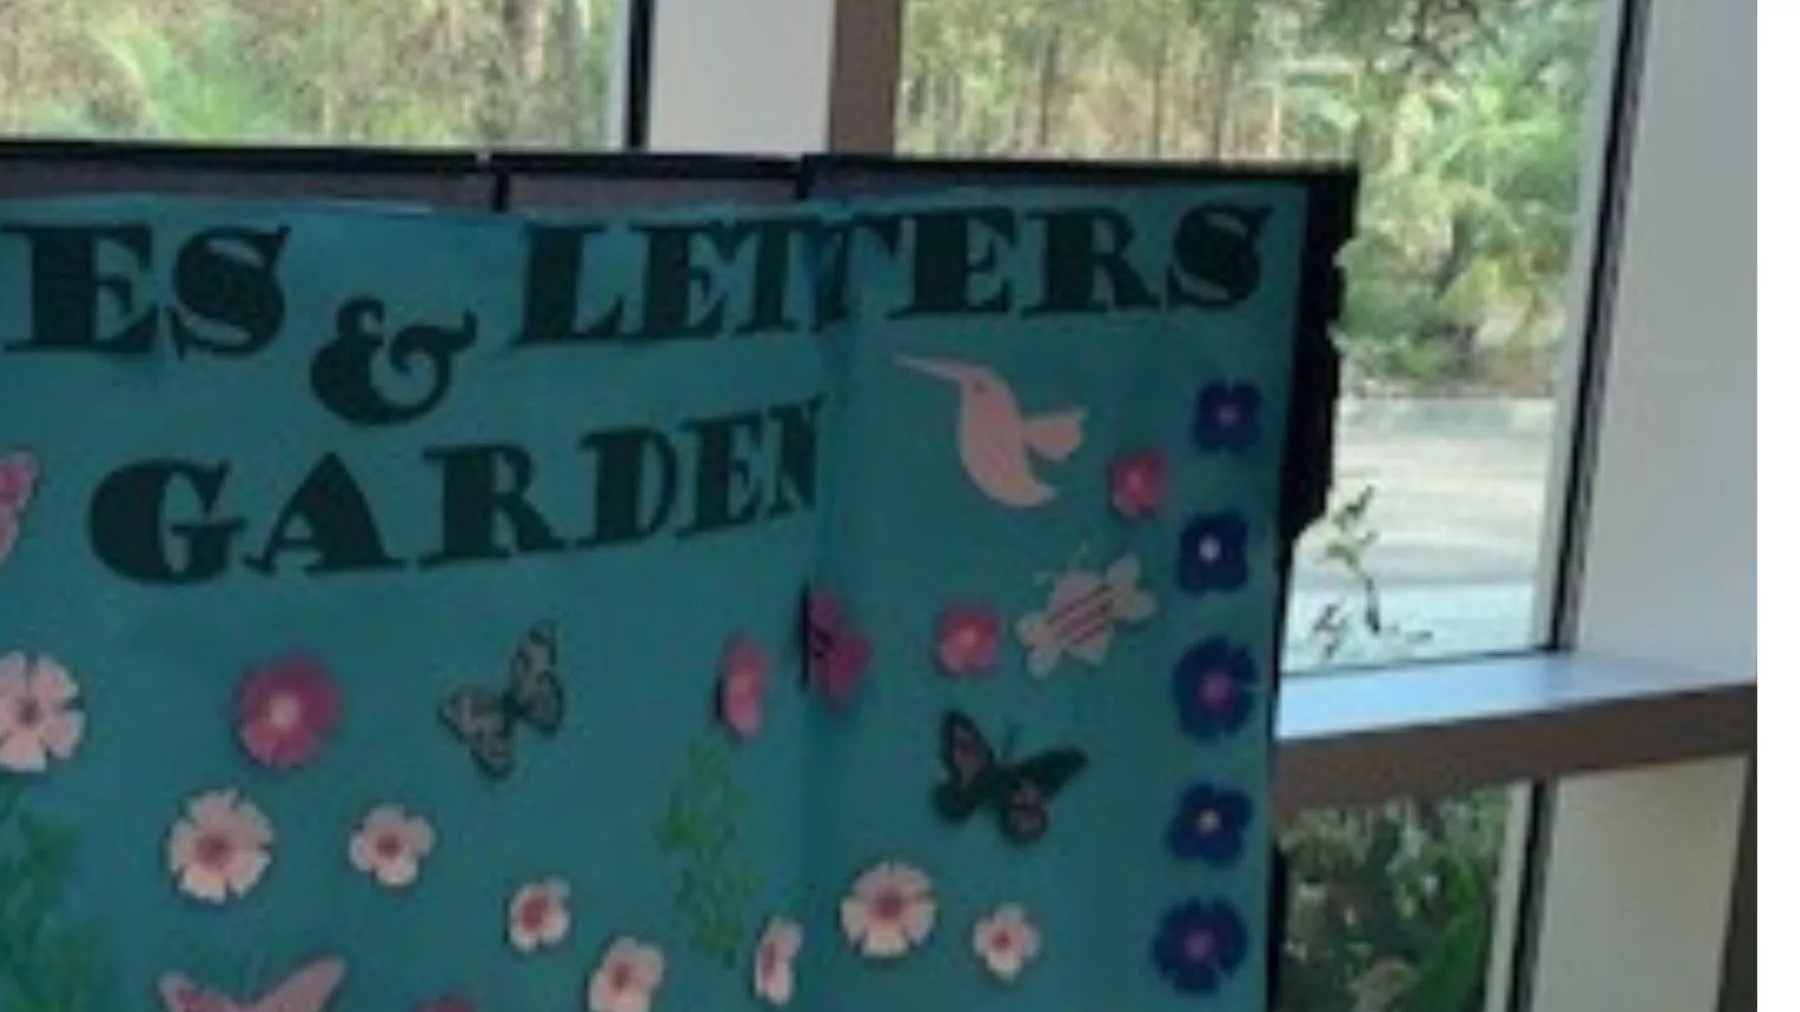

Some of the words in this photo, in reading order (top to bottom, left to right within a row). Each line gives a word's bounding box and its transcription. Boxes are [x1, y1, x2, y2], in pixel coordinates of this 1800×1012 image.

[310, 297, 478, 427] &
[506, 204, 1274, 348] LETTERS
[88, 392, 824, 586] GARDEN
